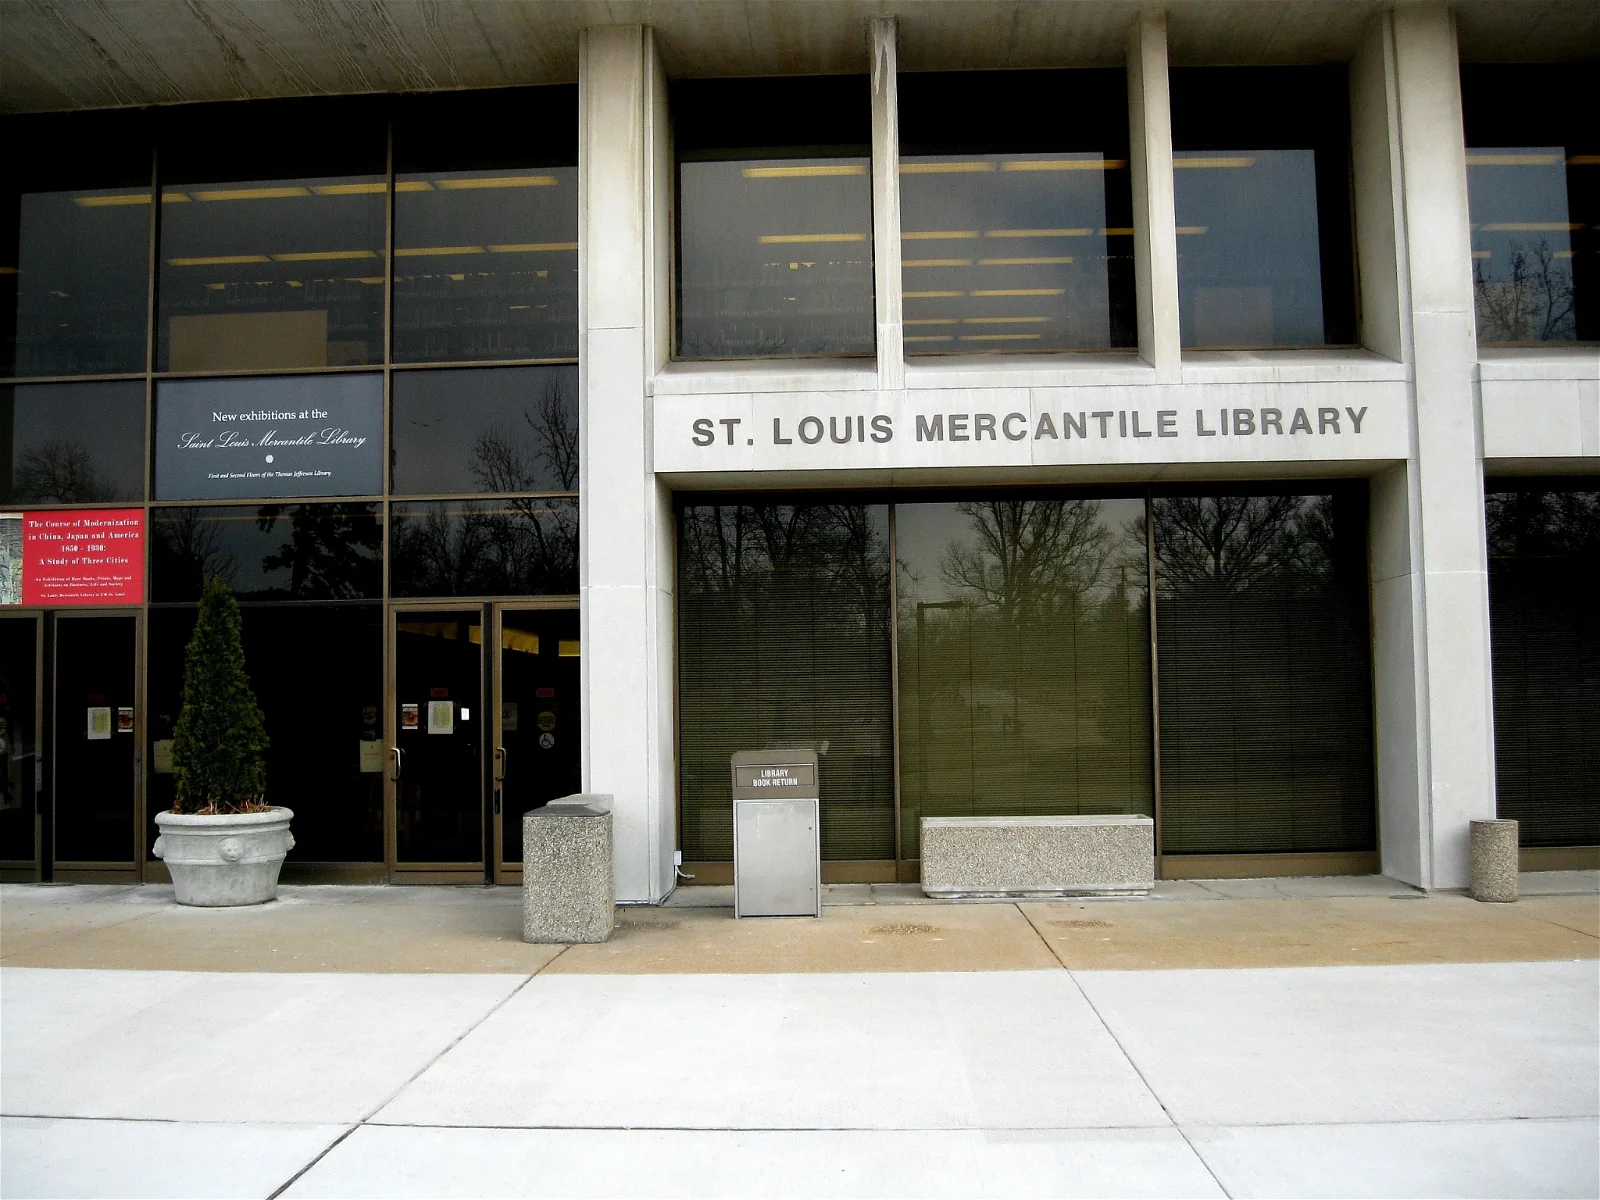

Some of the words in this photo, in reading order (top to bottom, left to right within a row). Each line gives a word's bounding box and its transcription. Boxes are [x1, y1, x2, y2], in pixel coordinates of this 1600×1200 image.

[212, 412, 237, 422] New
[240, 411, 296, 421] exhibitions
[299, 410, 309, 419] at
[311, 409, 328, 419] the
[691, 417, 754, 447] ST.
[772, 415, 894, 445] LOUIS
[915, 410, 1178, 442] MERCANTILE
[1196, 406, 1368, 437] LIBRARY
[177, 432, 214, 449] Saint
[215, 431, 249, 448] Louis
[251, 429, 317, 447] Mercantile
[316, 427, 367, 448] Library
[39, 533, 64, 541] China,
[67, 533, 89, 541] Japan
[48, 558, 69, 566] Study
[772, 778, 797, 786] RETURN
